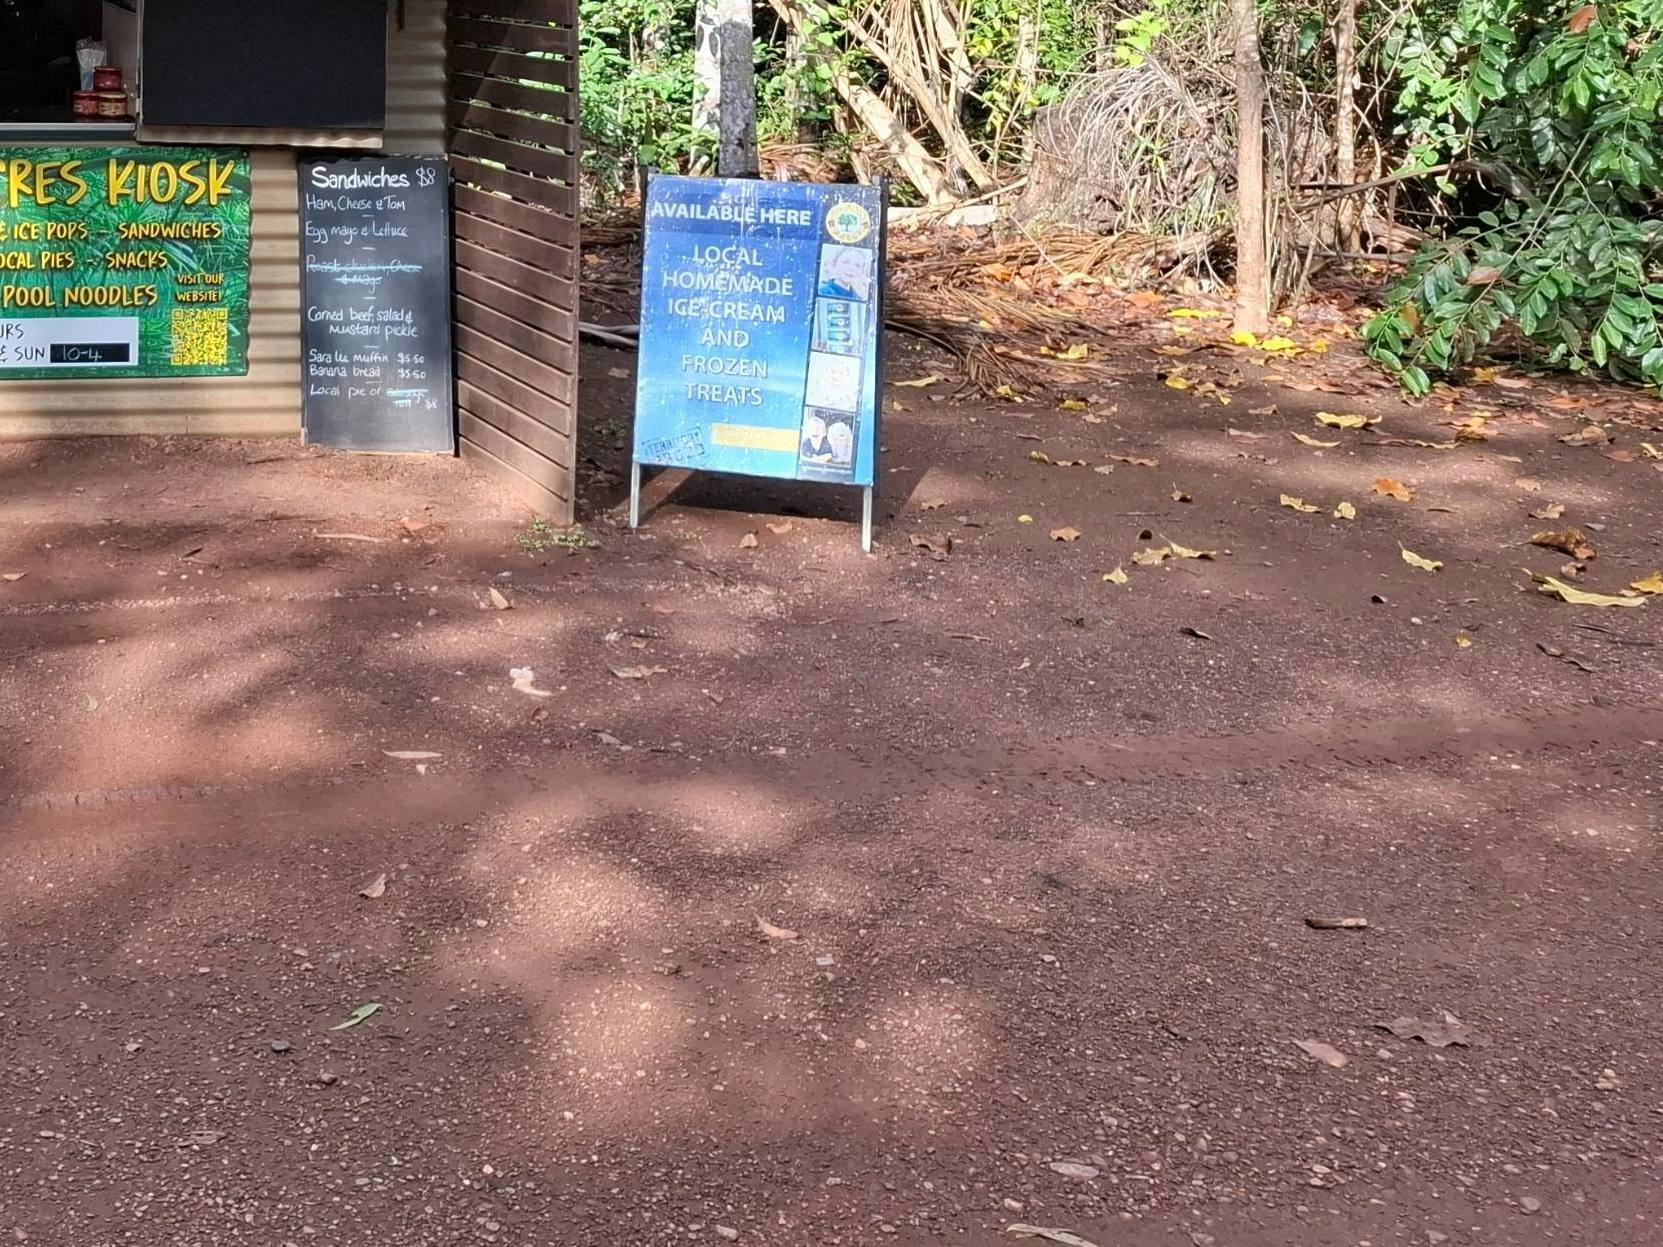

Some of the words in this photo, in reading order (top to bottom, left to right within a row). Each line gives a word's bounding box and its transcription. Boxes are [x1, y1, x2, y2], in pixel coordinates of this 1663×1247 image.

[107, 157, 235, 206] KIOSK
[311, 165, 410, 190] Sandwiches
[415, 165, 436, 188] $8
[306, 193, 337, 212] Ham,
[337, 195, 372, 210] Cheese
[651, 201, 757, 224] AVAILABLE
[759, 207, 812, 226] HERE
[14, 222, 39, 240] ICE
[47, 222, 88, 240] POPS
[118, 221, 223, 240] SANDWICHES
[306, 220, 328, 244] Egg
[331, 224, 359, 245] mayo
[372, 220, 409, 238] Lettuce
[41, 250, 75, 269] PIES
[105, 250, 168, 269] SNACKS
[693, 244, 763, 267] LOCAL
[176, 273, 202, 285] VISIT
[205, 273, 225, 285] OUR
[662, 270, 793, 296] HOMEMADE
[3, 285, 56, 308] POOL
[64, 284, 159, 308] NOODLES
[176, 289, 223, 303] WEBSITE!
[307, 306, 344, 322] Corned
[376, 307, 404, 323] salad
[385, 323, 419, 341] pickle
[700, 327, 750, 348] AND
[14, 346, 45, 362] SUN
[62, 344, 103, 361] 10-4
[308, 348, 331, 364] Sara
[397, 353, 425, 365] $5.50
[309, 364, 347, 377] Banana
[353, 365, 380, 378] bread
[397, 368, 426, 379] $5.50
[681, 354, 768, 378] FROZEN
[310, 383, 341, 396] Local
[348, 386, 367, 399] pie
[369, 387, 382, 396] or
[685, 381, 763, 406] TREATS
